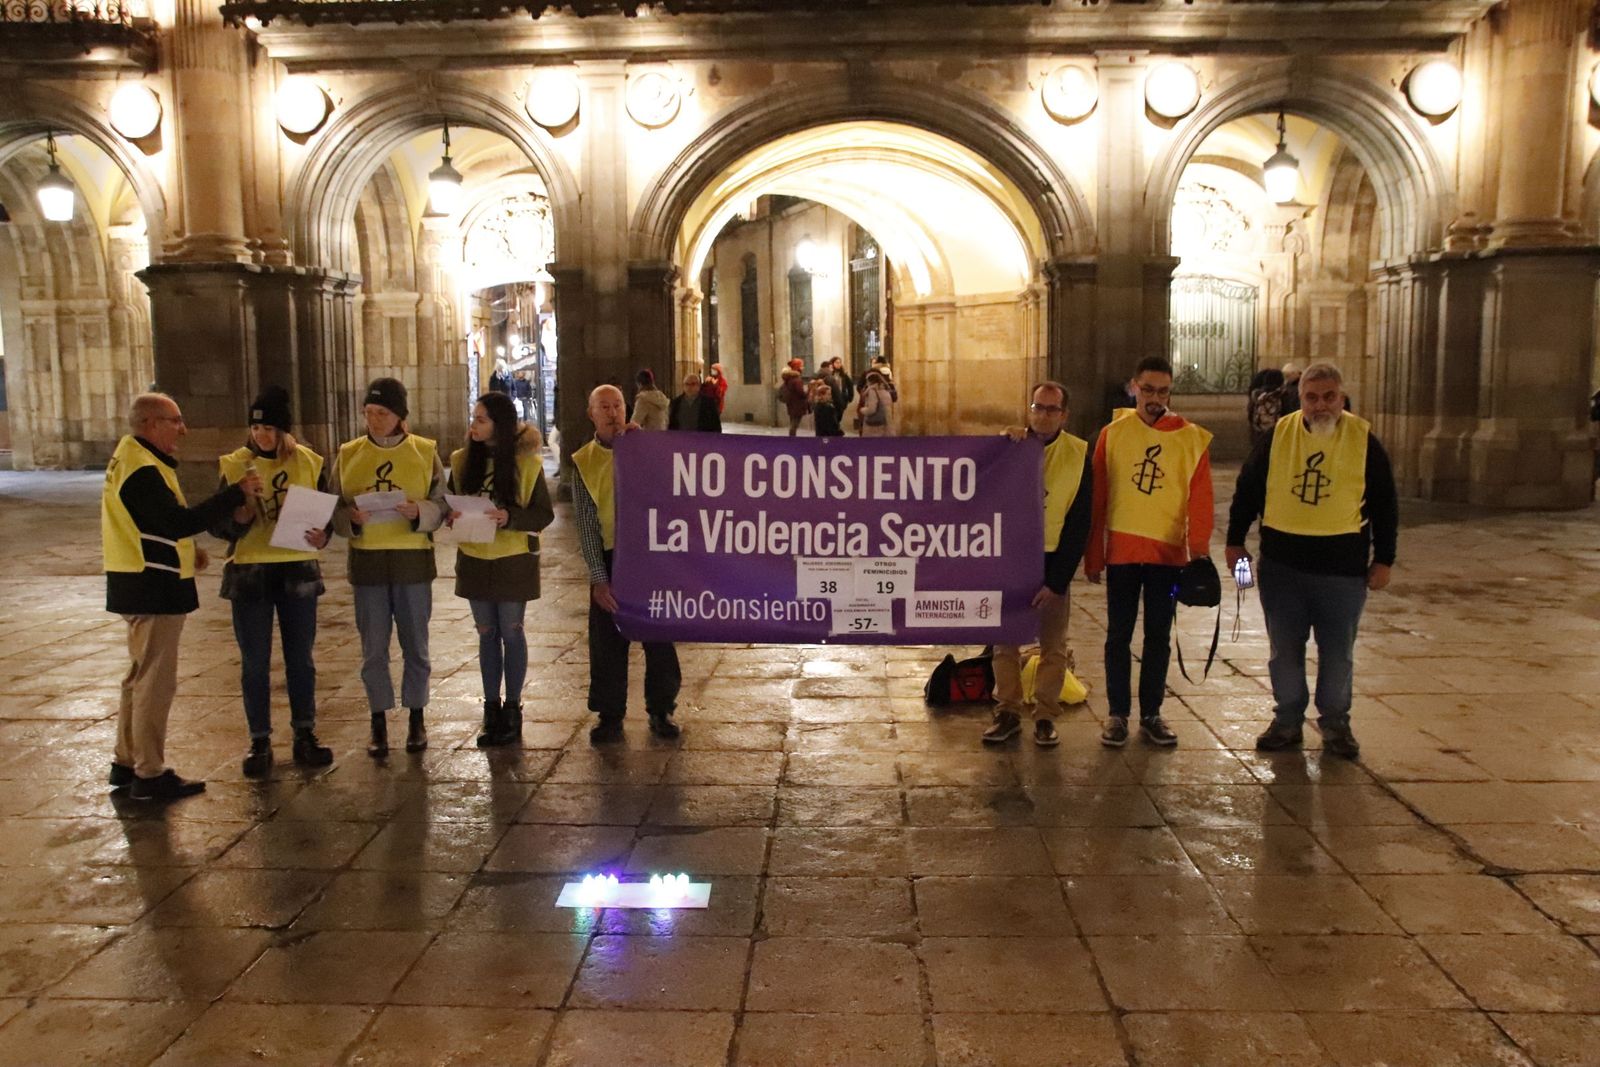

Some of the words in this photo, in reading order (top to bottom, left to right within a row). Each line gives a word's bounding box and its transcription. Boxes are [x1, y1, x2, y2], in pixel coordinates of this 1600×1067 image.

[672, 453, 725, 497] NO
[744, 454, 976, 501] CONSIENTO
[648, 508, 689, 553] La
[699, 509, 869, 556] Violencia
[880, 512, 1002, 558] Sexual
[820, 581, 838, 594] 38
[877, 581, 895, 594] 19
[648, 591, 826, 622] #NoConsiento
[915, 598, 965, 611] AMNISTÍA
[914, 611, 965, 619] INTERNACIONAL
